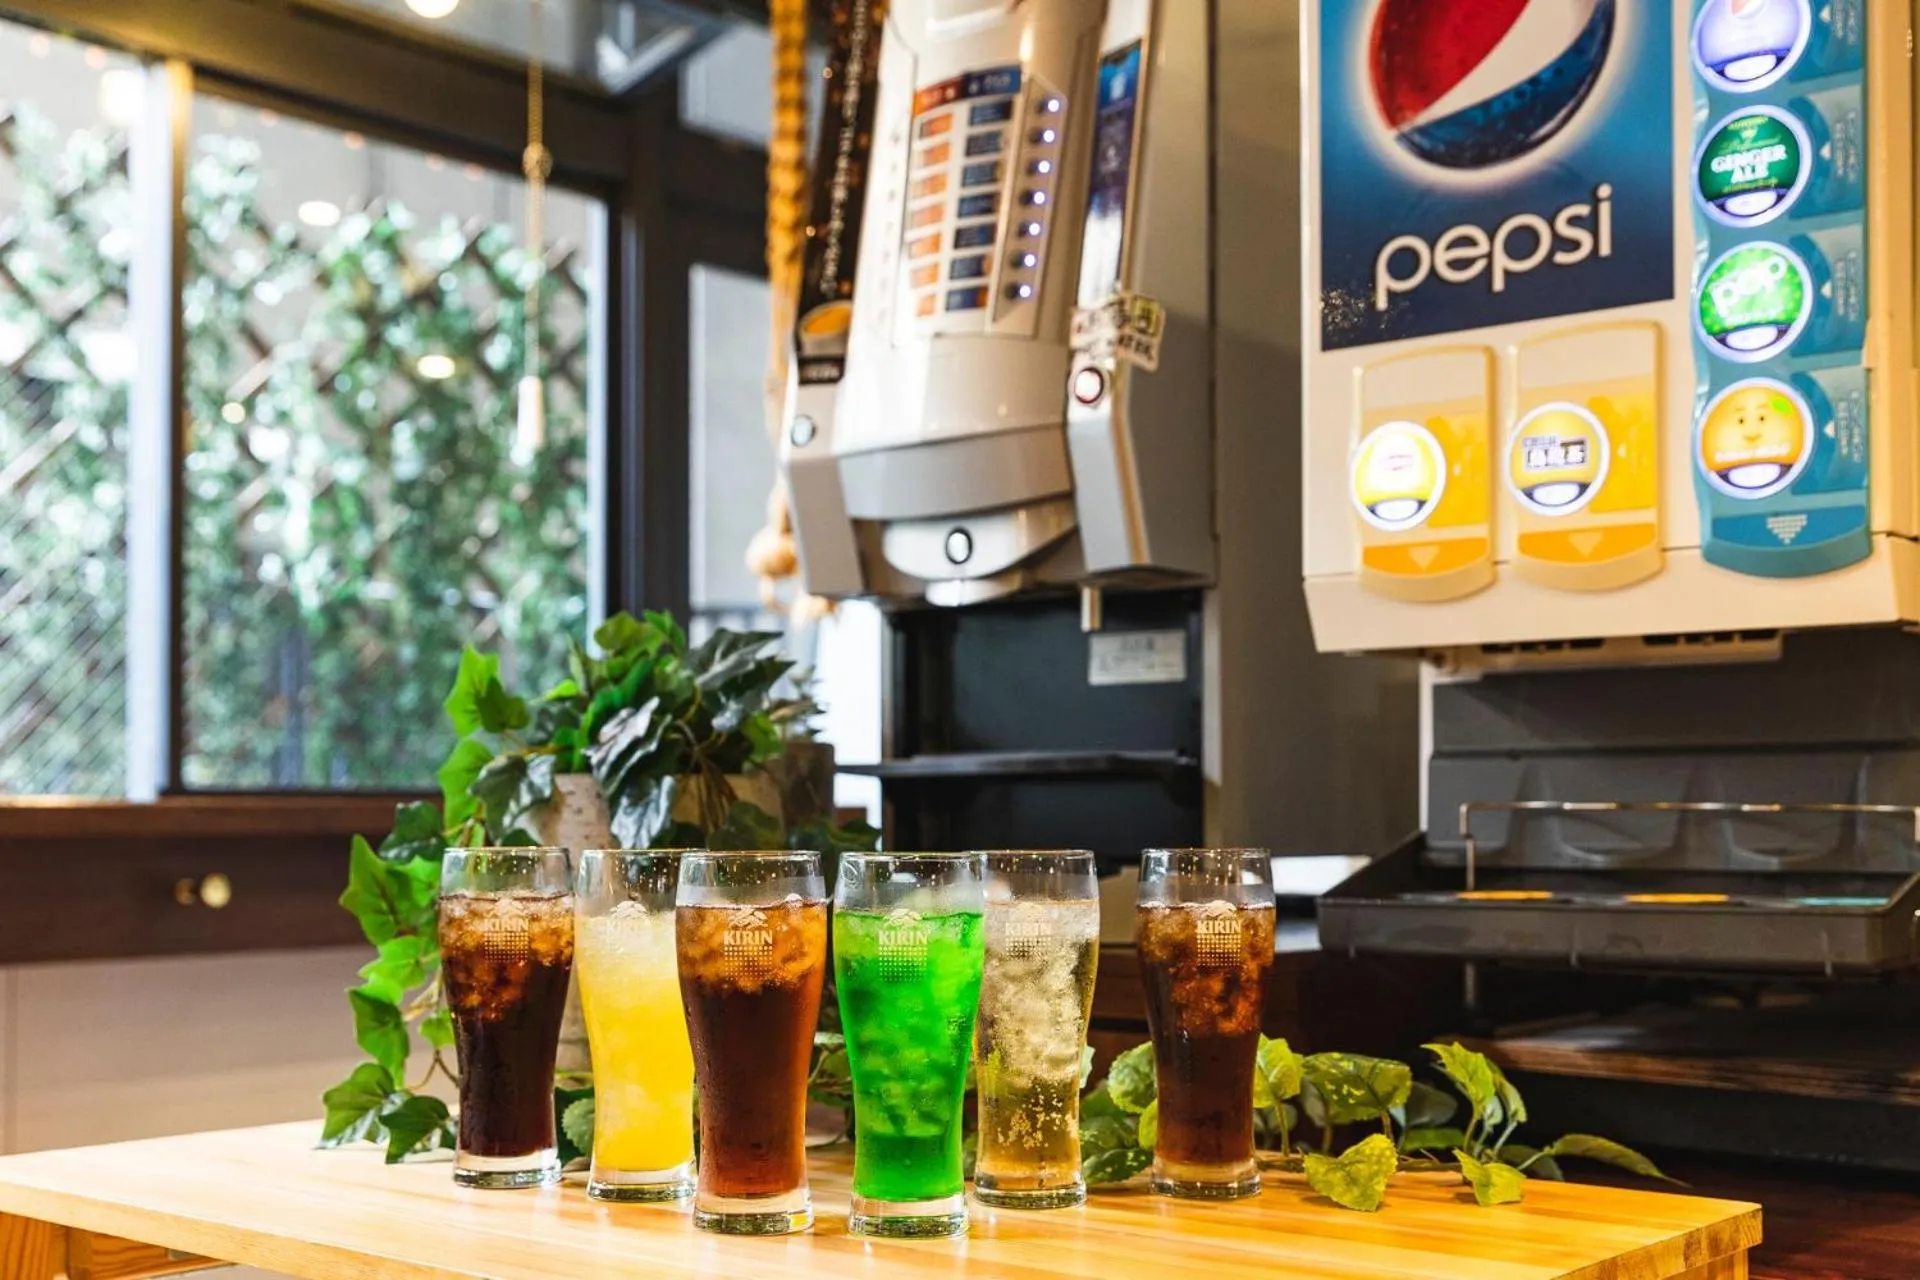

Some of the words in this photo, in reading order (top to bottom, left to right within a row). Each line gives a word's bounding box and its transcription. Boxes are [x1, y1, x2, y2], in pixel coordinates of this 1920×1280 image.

[1711, 144, 1787, 173] GINGER
[1731, 164, 1769, 183] ALE
[1375, 183, 1613, 312] pepsi
[484, 919, 528, 932] KIRIN
[1197, 920, 1242, 934] KIRIN
[723, 930, 773, 945] KIRIN
[878, 930, 928, 945] KIRIN
